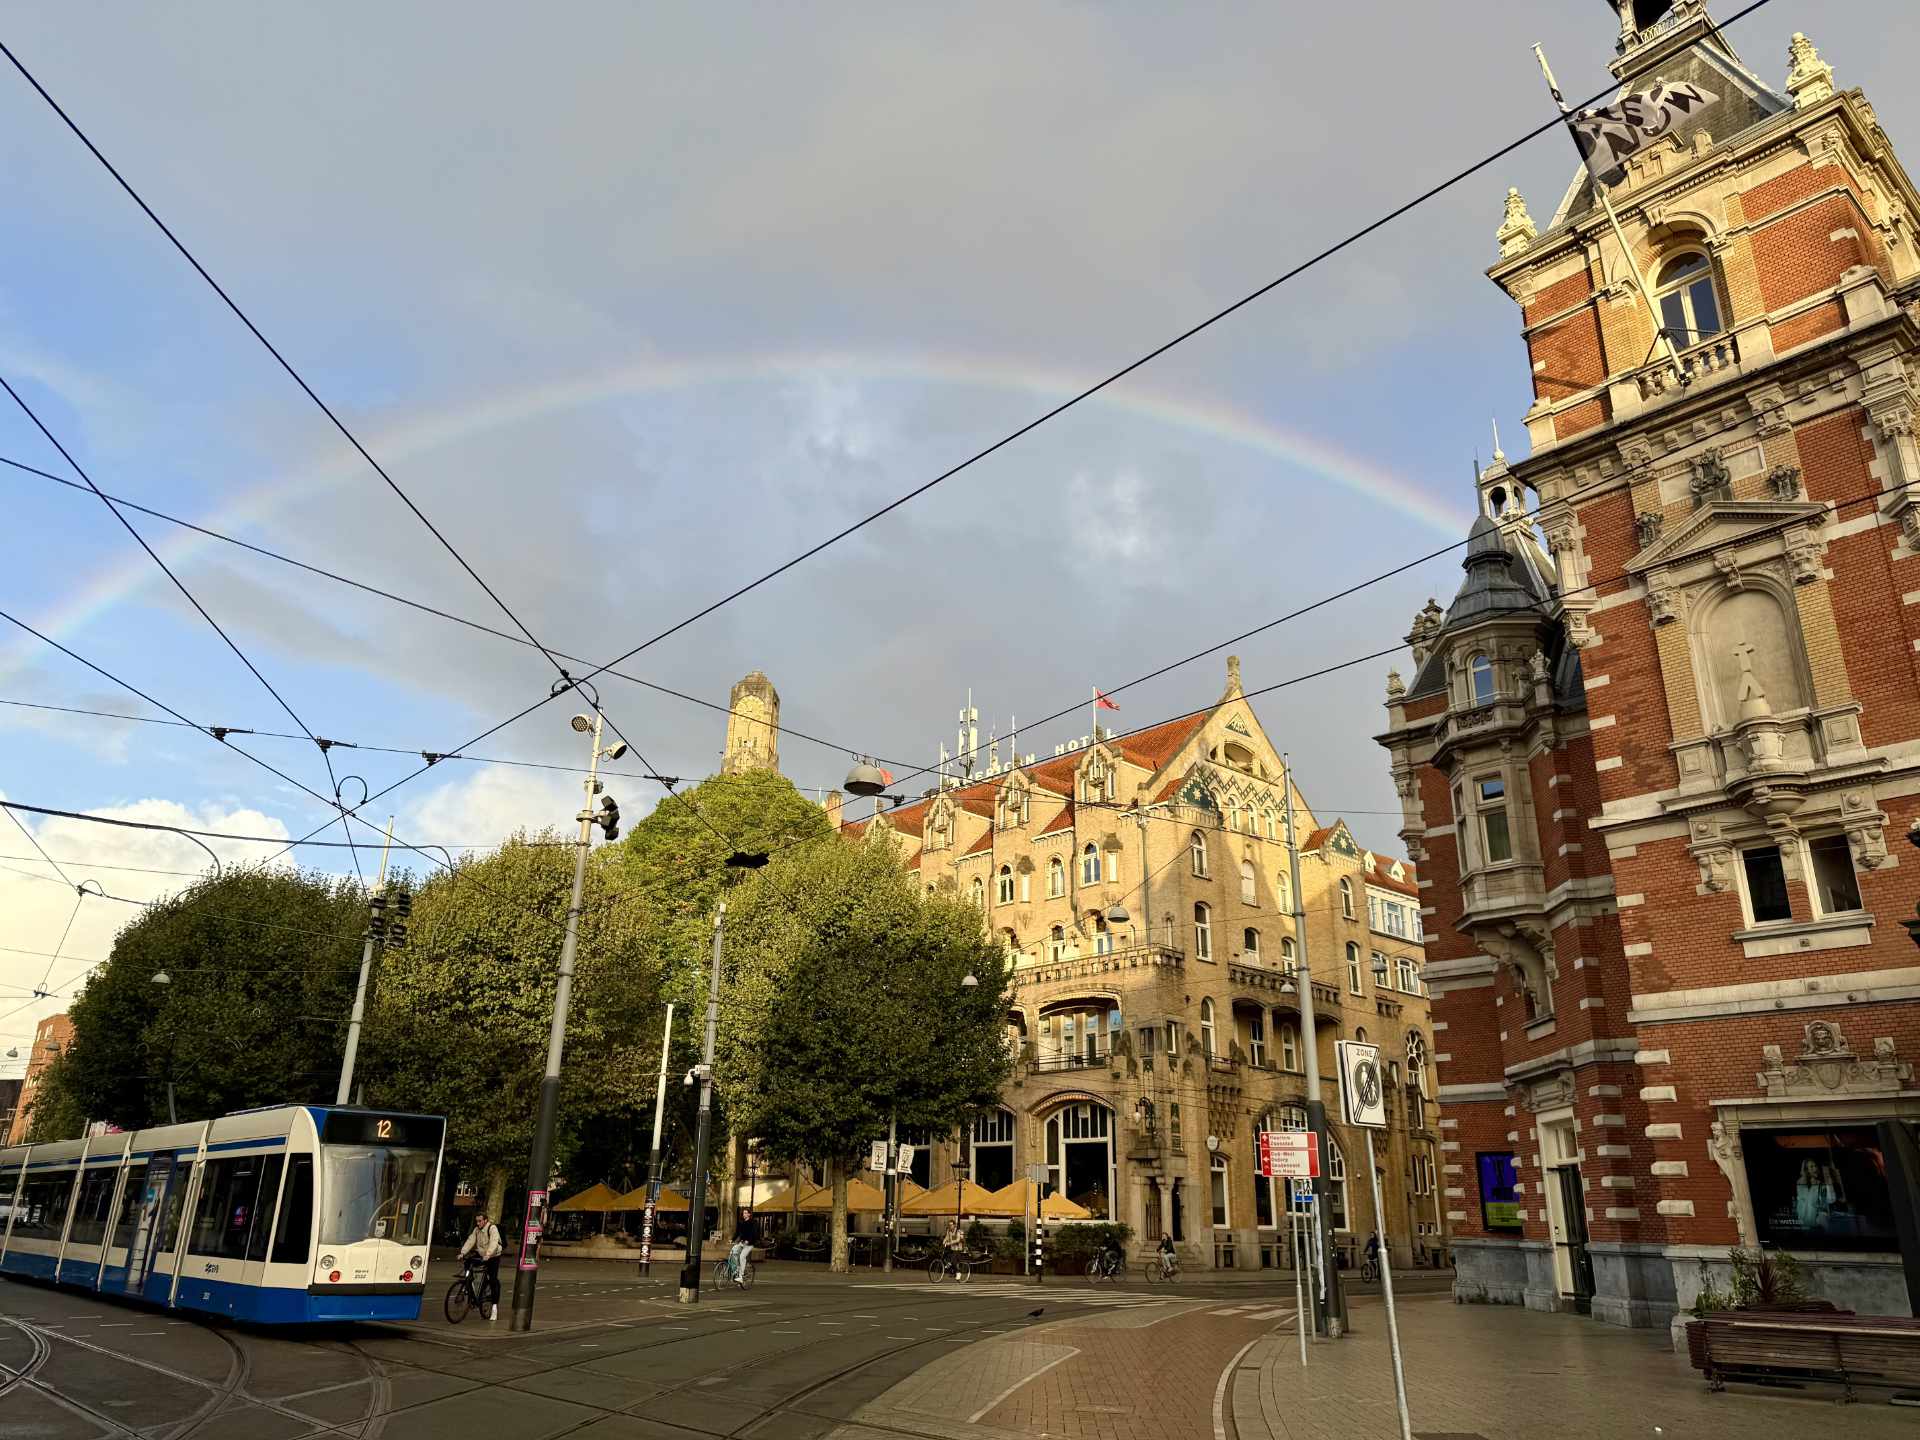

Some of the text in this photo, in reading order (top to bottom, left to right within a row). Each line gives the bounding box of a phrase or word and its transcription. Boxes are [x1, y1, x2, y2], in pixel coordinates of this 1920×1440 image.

[1055, 728, 1117, 755] HOTL
[1356, 1048, 1374, 1057] ZONE
[377, 1119, 392, 1138] 12
